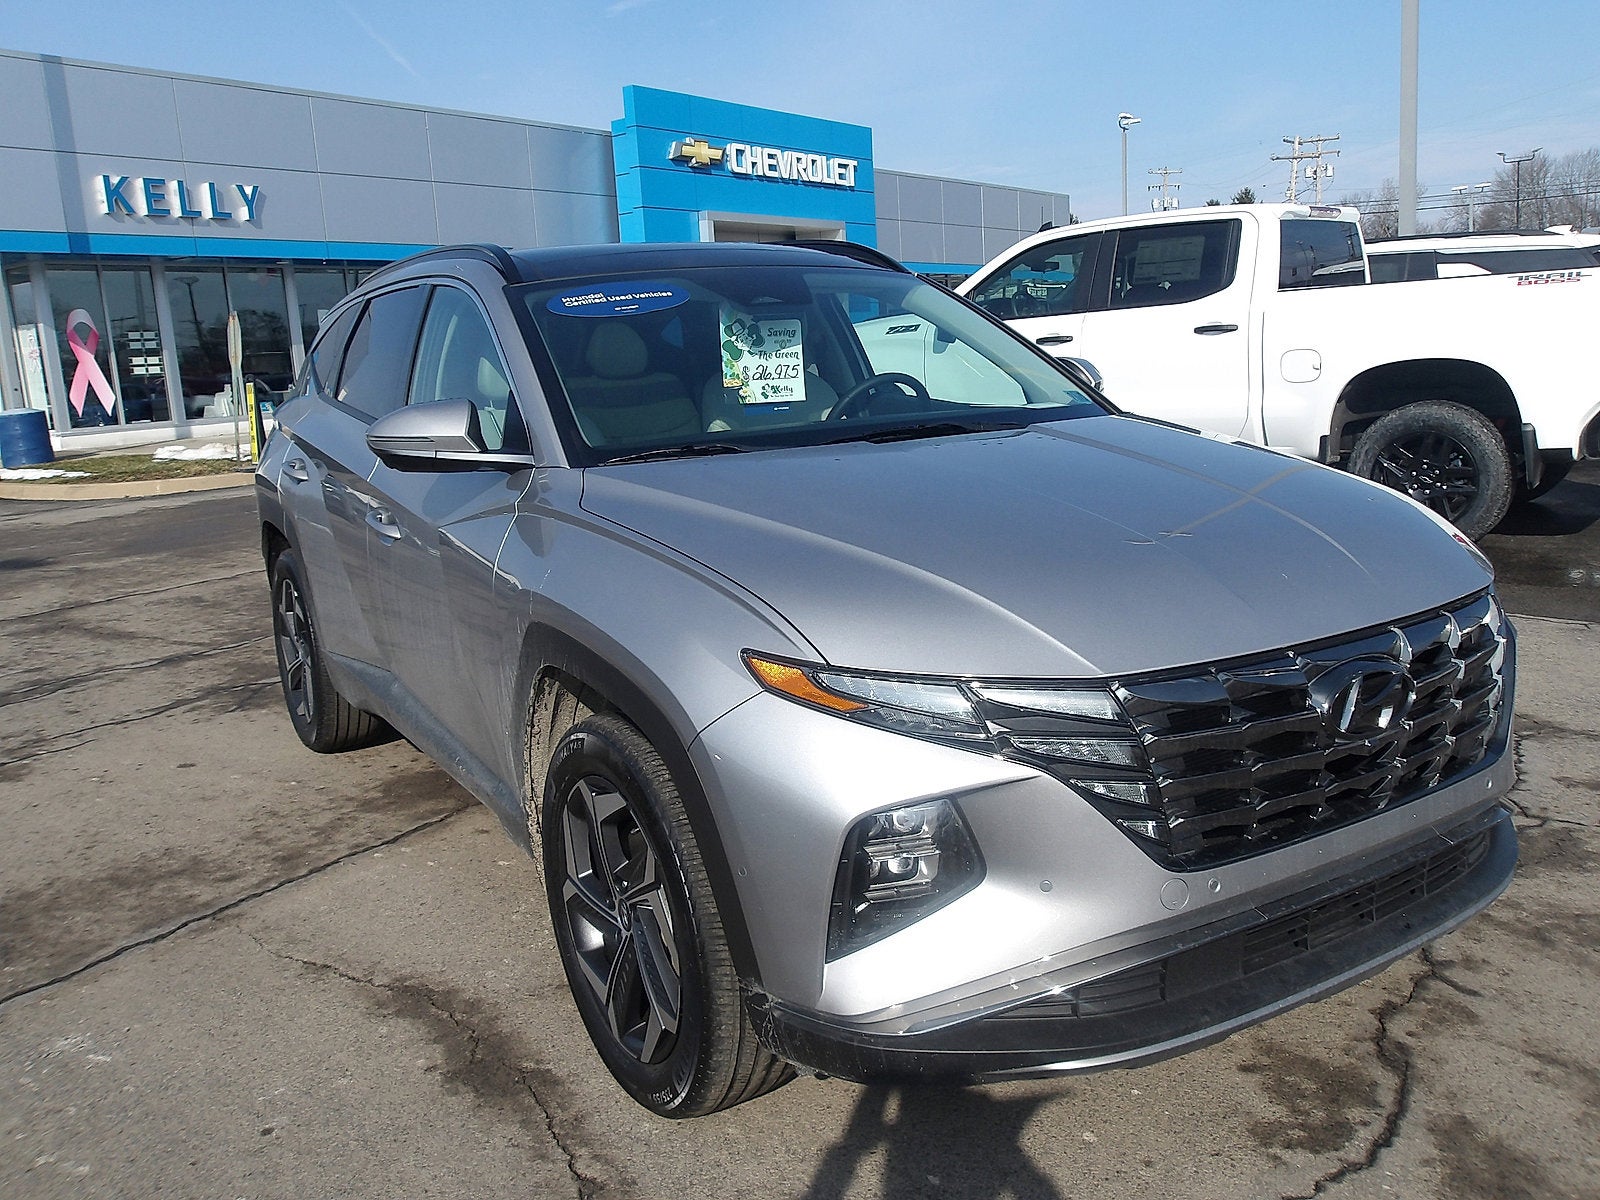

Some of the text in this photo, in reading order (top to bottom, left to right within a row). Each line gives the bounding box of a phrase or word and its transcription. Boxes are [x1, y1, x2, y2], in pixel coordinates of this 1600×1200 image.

[726, 143, 858, 187] CHEVROLET
[98, 174, 260, 222] KELLY
[1517, 278, 1581, 286] BOSS
[561, 292, 604, 303] Hyundai
[564, 291, 673, 307] Certified Used Vehicles
[767, 327, 797, 339] Saving
[757, 349, 800, 361] The Green
